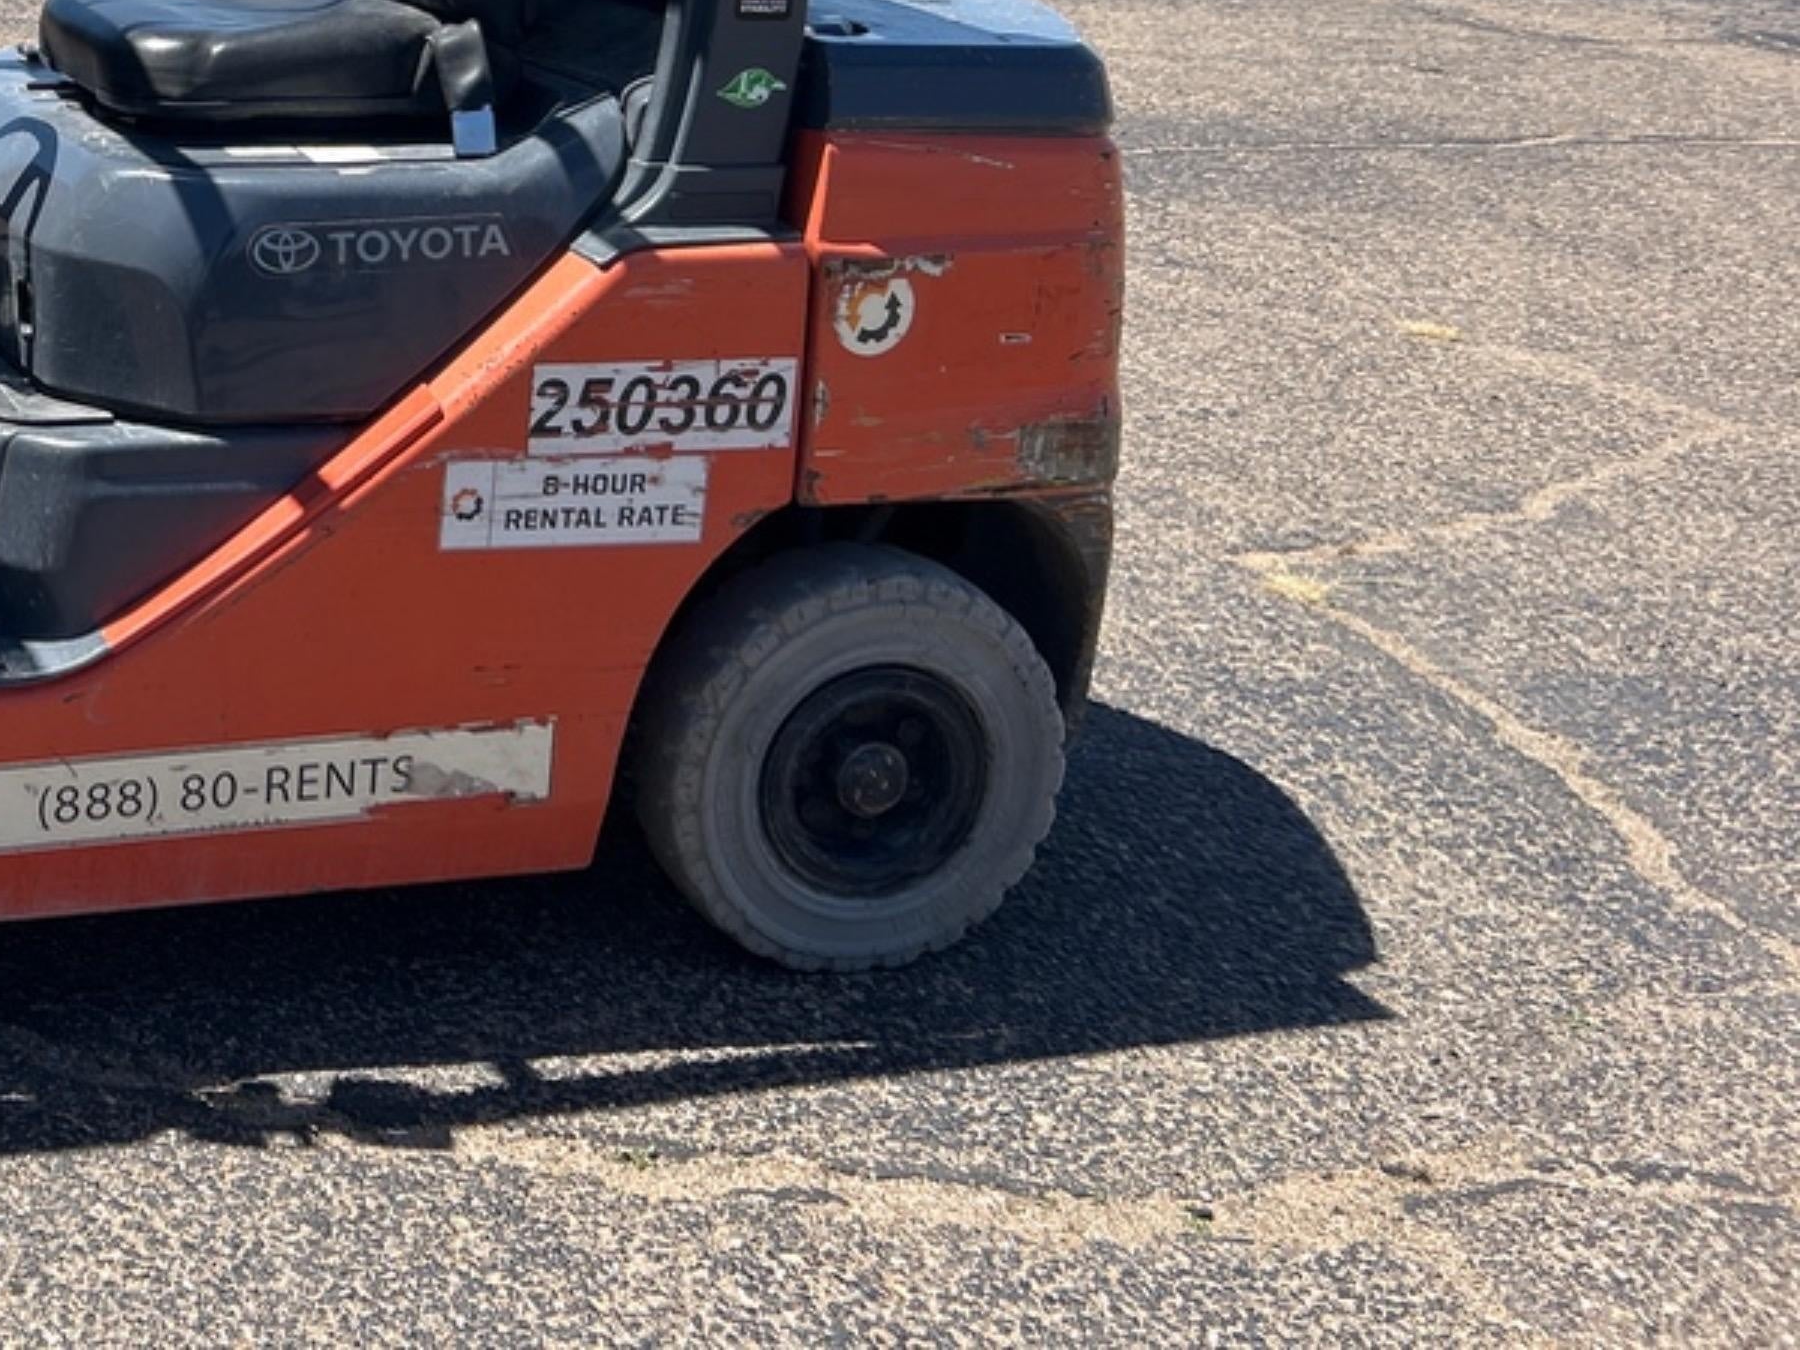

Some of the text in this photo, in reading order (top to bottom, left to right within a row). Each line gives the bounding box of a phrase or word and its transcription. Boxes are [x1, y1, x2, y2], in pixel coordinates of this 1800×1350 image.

[328, 224, 511, 265] TOYOTA
[530, 372, 788, 437] 250360
[542, 473, 647, 497] 8-HOUR
[504, 504, 686, 530] RENTAL RATE
[37, 755, 415, 831] (888) 80-RENTS
